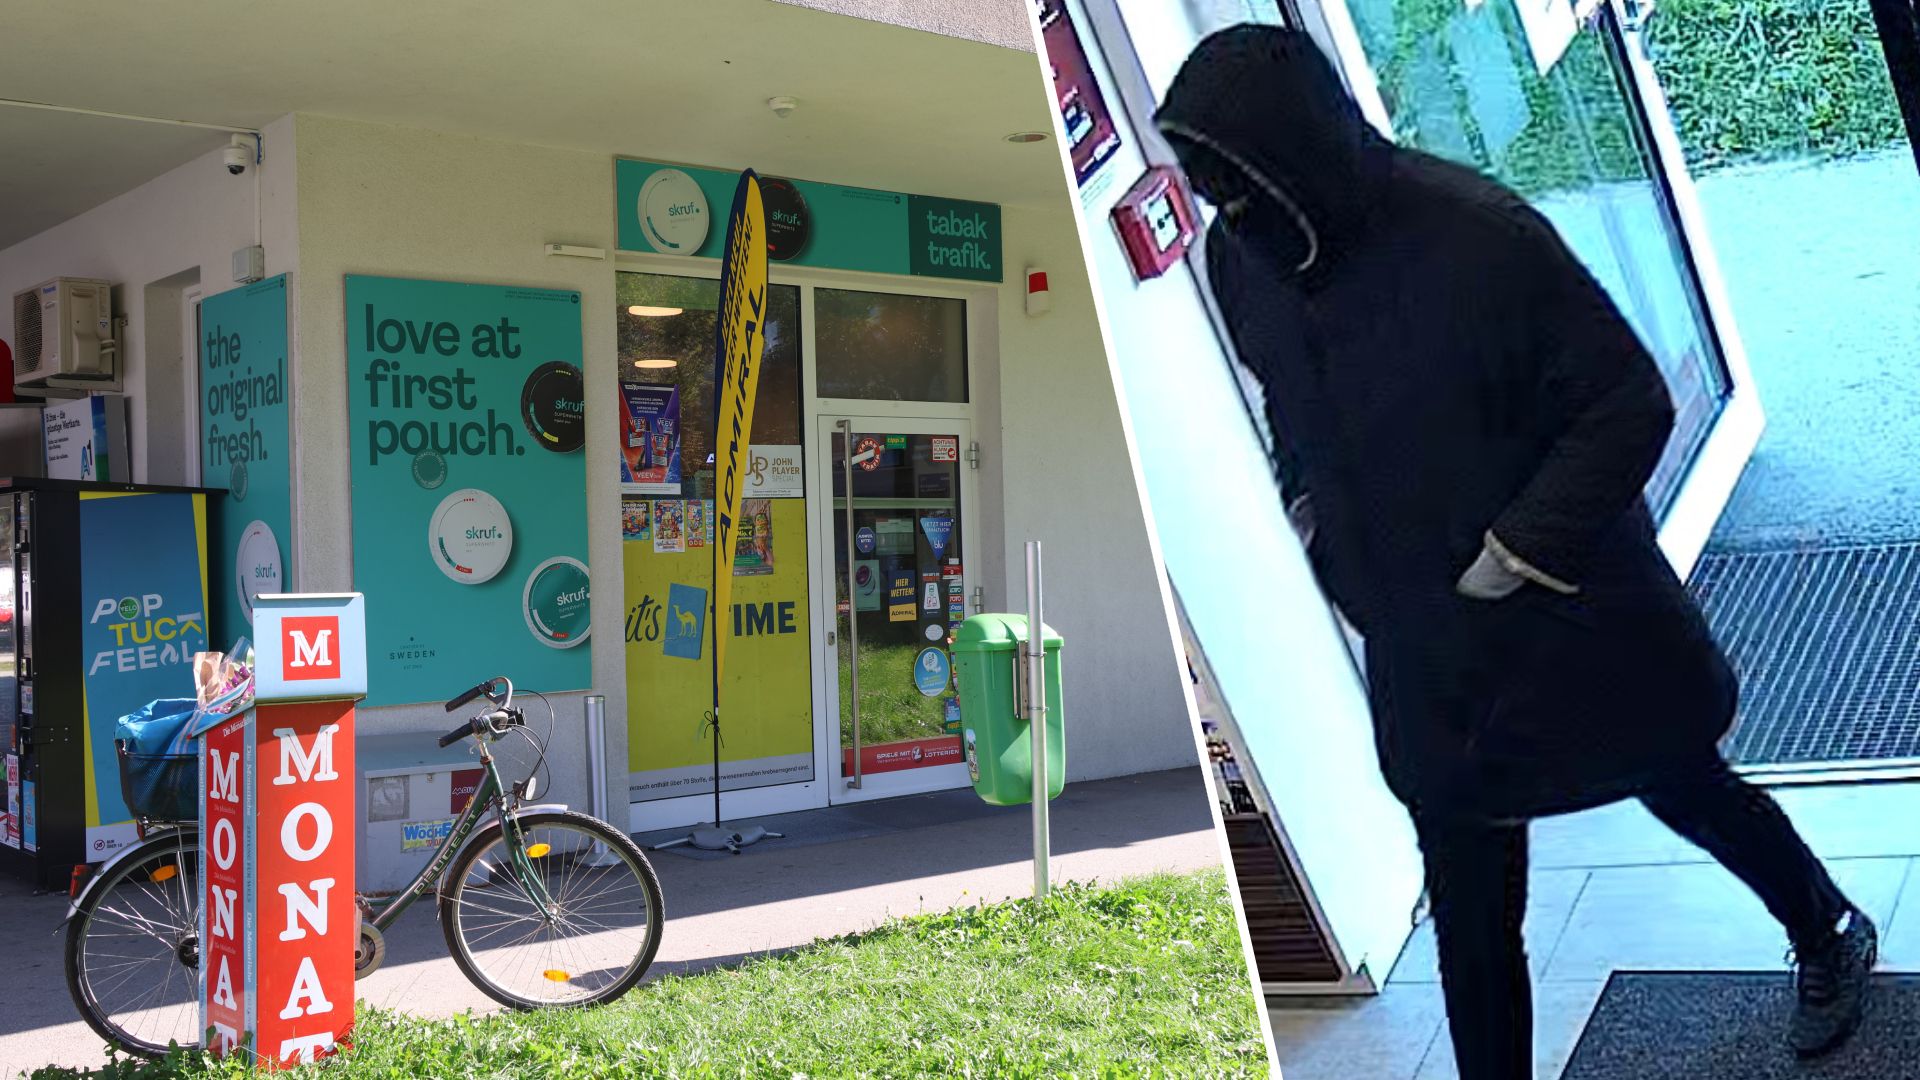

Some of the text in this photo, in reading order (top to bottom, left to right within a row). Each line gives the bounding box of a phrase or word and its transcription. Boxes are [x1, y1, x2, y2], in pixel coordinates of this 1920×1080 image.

[927, 209, 988, 239] tabak
[927, 240, 991, 270] trafik.
[726, 213, 753, 389] HIER WETTEN!
[206, 325, 241, 369] the
[365, 303, 522, 359] love at
[208, 358, 284, 422] original
[364, 358, 478, 410] first
[208, 418, 268, 467] fresh.
[368, 408, 525, 466] pouch.
[719, 282, 764, 568] ADMIRAL
[81, 439, 93, 480] A1
[772, 457, 793, 466] JOHN
[772, 466, 800, 475] PLAYER
[890, 587, 915, 598] WETTEN!
[895, 578, 909, 588] HIER
[625, 594, 662, 643] it's
[710, 600, 797, 637] IME
[891, 609, 915, 617] ADMIRAL
[289, 629, 332, 668] M
[389, 649, 436, 660] SWEDEN
[924, 749, 960, 758] LOTTERIEN
[404, 822, 452, 841] WOCHE
[413, 810, 477, 895] PEUGEOT
